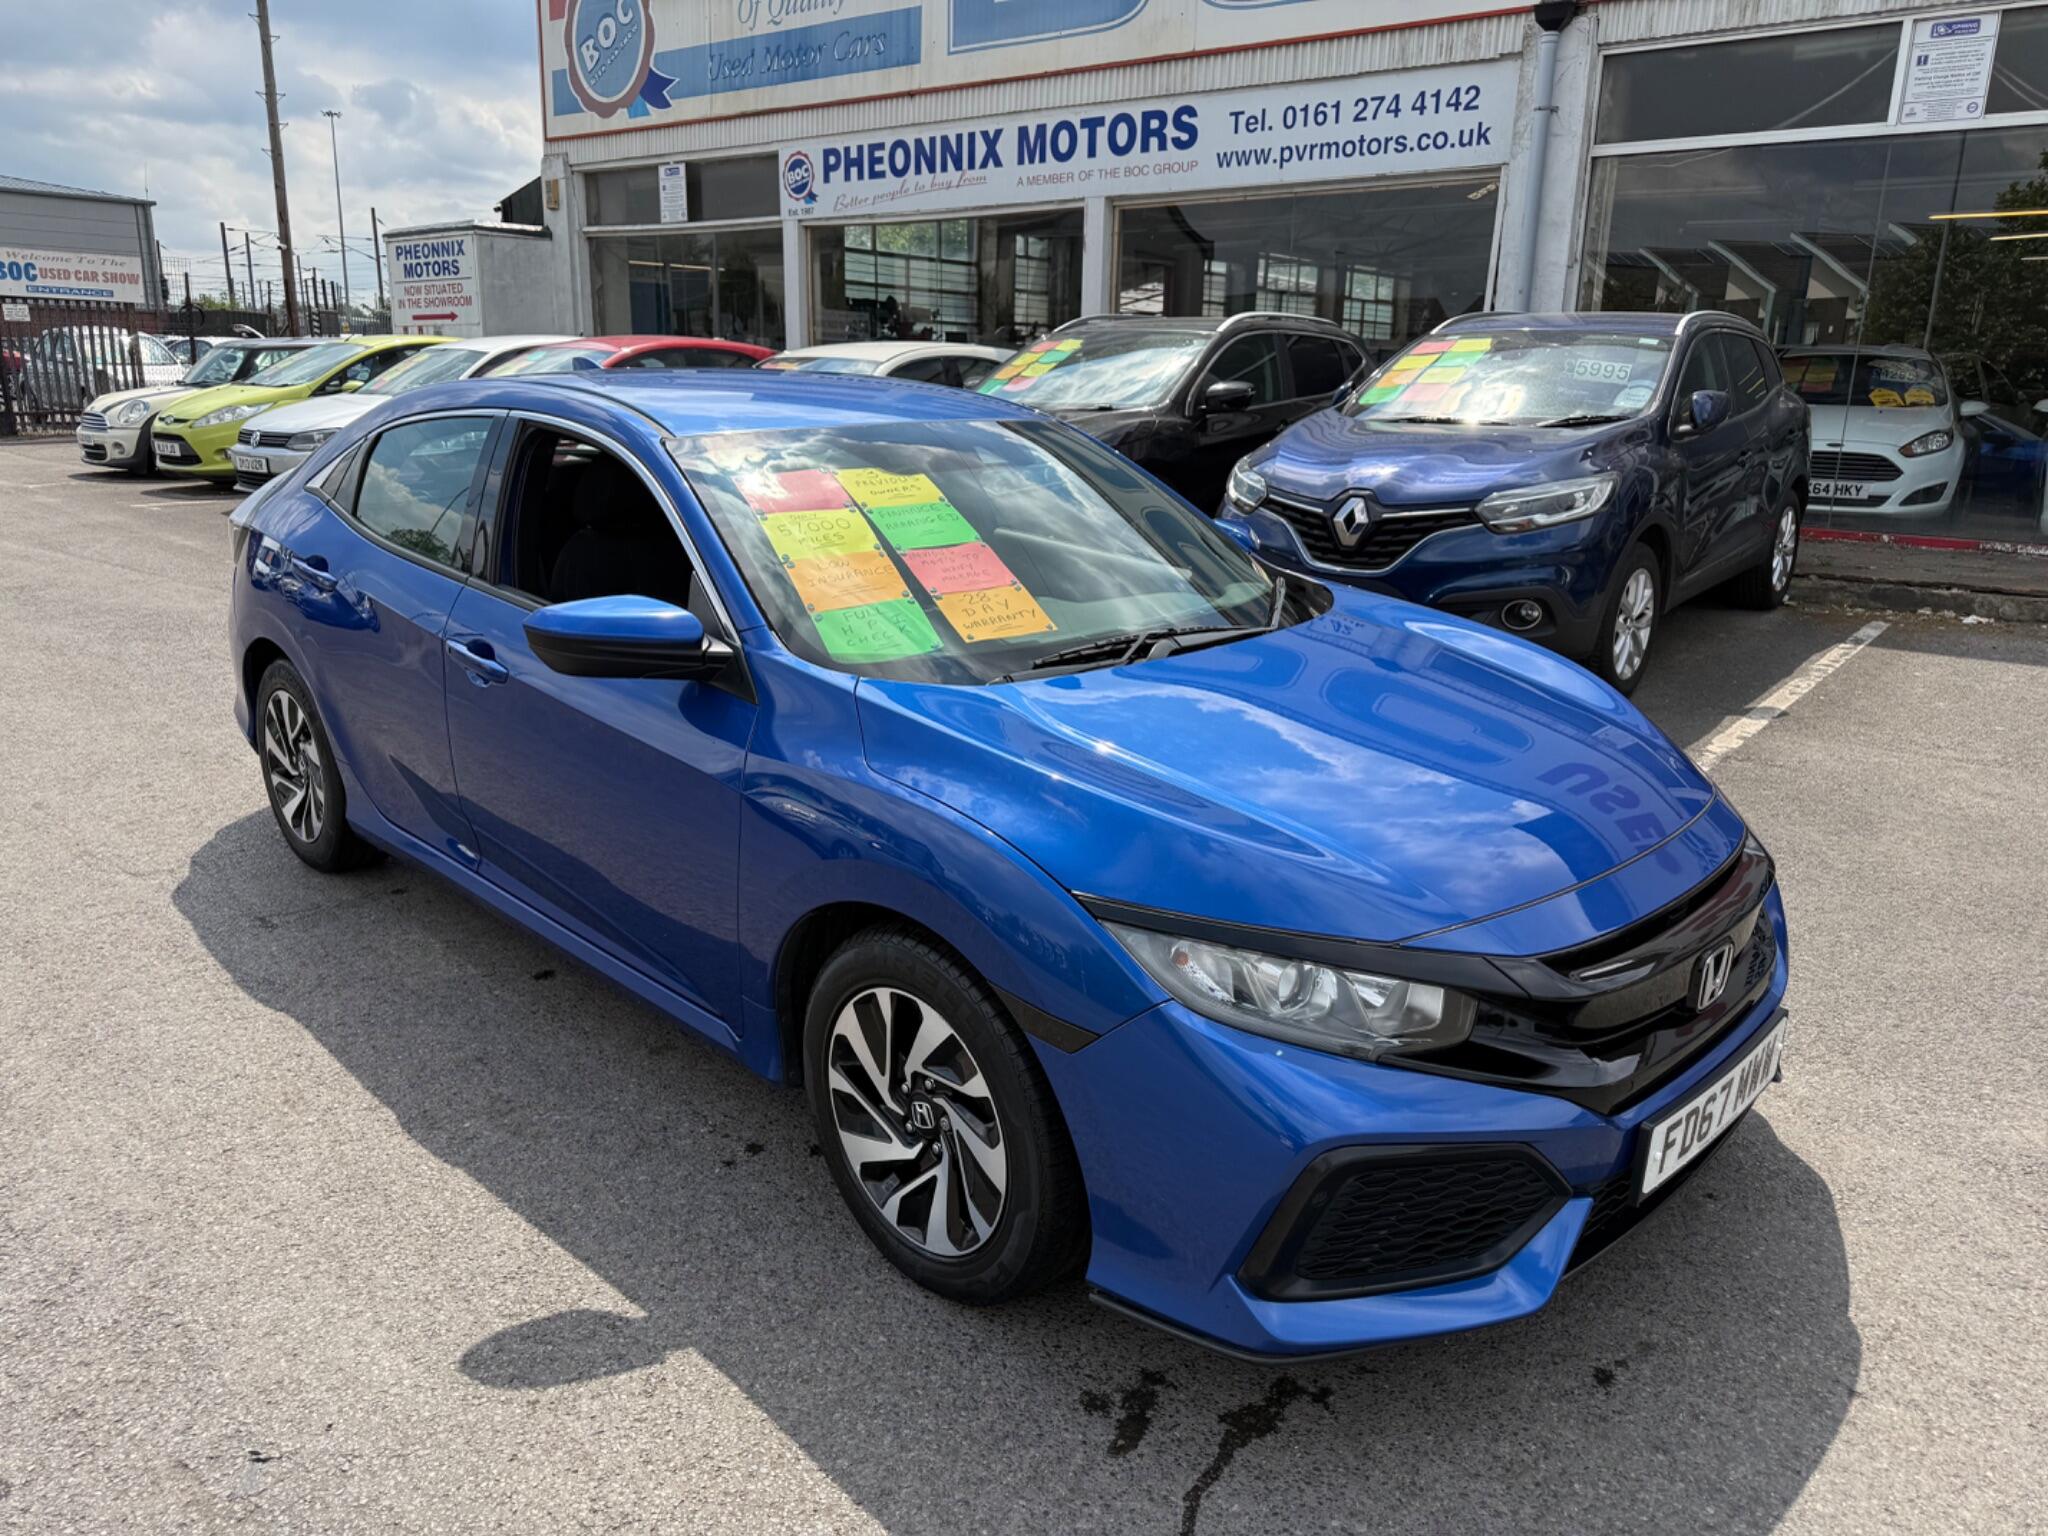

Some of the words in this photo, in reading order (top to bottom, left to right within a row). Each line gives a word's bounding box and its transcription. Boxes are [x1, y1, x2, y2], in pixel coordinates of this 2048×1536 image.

[580, 0, 634, 73] BOC
[708, 48, 756, 81] Used
[760, 42, 827, 74] Motor
[833, 31, 887, 62] Cars
[1229, 108, 1273, 135] Tel.
[1282, 100, 1342, 130] 0161
[1353, 93, 1402, 123] 274
[1411, 84, 1482, 116] 4142
[822, 129, 1005, 184] PHEONNIX
[1017, 104, 1199, 166] MOTORS
[1216, 121, 1492, 169] www.pvrmotors.co.uk
[788, 164, 810, 184] BOC
[1016, 176, 1024, 187] A
[1026, 172, 1074, 187] MEMBER
[1078, 169, 1094, 182] OF
[1099, 166, 1121, 180] THE
[1124, 164, 1150, 178] BOC
[1153, 160, 1199, 176] GROUP
[833, 193, 869, 213] Better
[872, 179, 911, 206] people
[914, 180, 926, 192] to
[930, 173, 953, 191] buy
[956, 170, 987, 189] from
[5, 250, 73, 263] Welcome
[75, 255, 95, 266] To
[98, 256, 127, 267] The
[395, 239, 466, 261] PHEONNIX
[38, 267, 71, 281] USED
[73, 269, 99, 284] CAR
[102, 270, 140, 285] SHOW
[403, 259, 460, 279] MOTORS
[27, 285, 113, 297] ENTRANCE
[404, 284, 423, 296] NOW
[424, 282, 464, 296] SITUATED
[398, 298, 405, 309] IN
[407, 297, 422, 309] THE
[423, 295, 472, 308] SHOWROOM
[1834, 484, 1863, 496] HKY
[878, 502, 942, 519] FINANCE
[807, 565, 895, 588] INSURANCE
[963, 608, 1037, 630] WARRANTY
[1658, 1076, 1735, 1174] FD67
